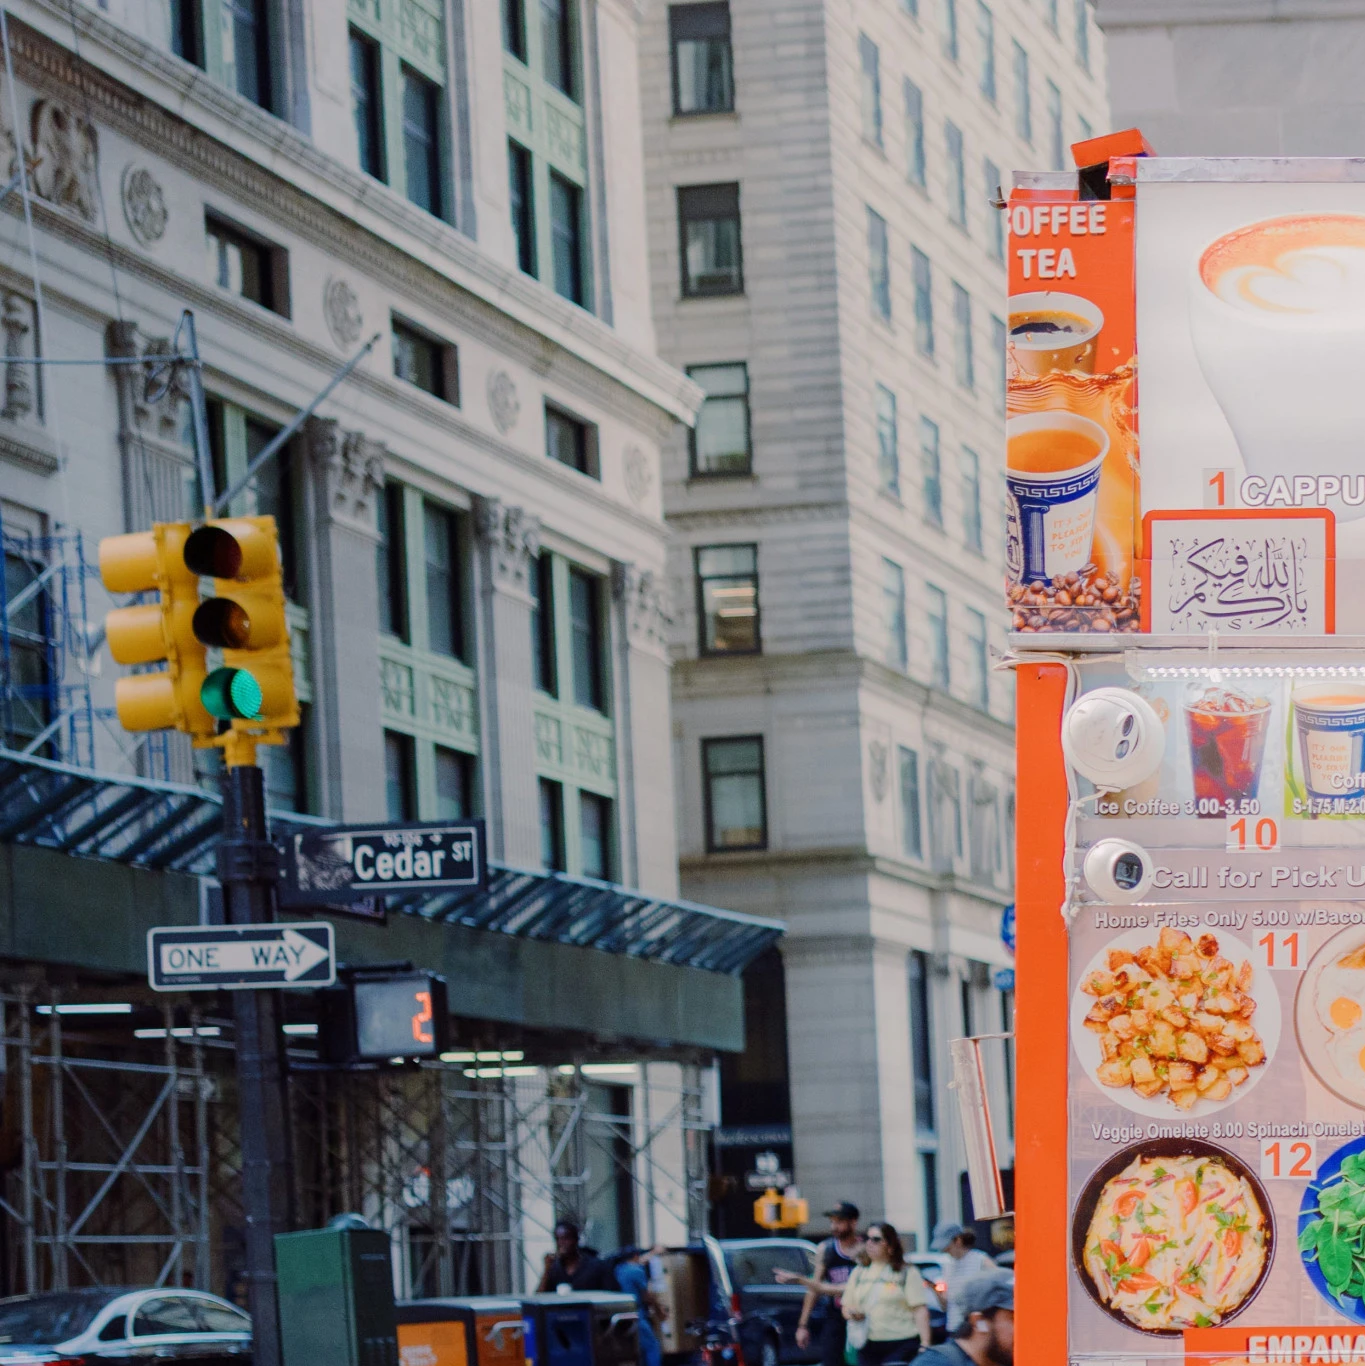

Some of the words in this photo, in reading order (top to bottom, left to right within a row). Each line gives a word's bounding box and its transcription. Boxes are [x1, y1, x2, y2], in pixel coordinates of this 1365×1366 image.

[1016, 247, 1077, 279] TEA
[1208, 470, 1226, 507] 1
[1093, 800, 1119, 816] Ice
[1123, 799, 1180, 816] Coffee
[1184, 799, 1261, 817] 3.00-3.50
[1228, 817, 1278, 851] 10
[353, 844, 446, 881] Cedar
[451, 840, 473, 862] ST
[1151, 866, 1208, 888] Call
[1216, 866, 1247, 888] for
[1270, 866, 1337, 888] Pick
[168, 947, 219, 969] ONE
[251, 944, 306, 966] WAY
[1258, 932, 1301, 968] 11
[411, 991, 433, 1043] 2
[1263, 1142, 1313, 1178] 12
